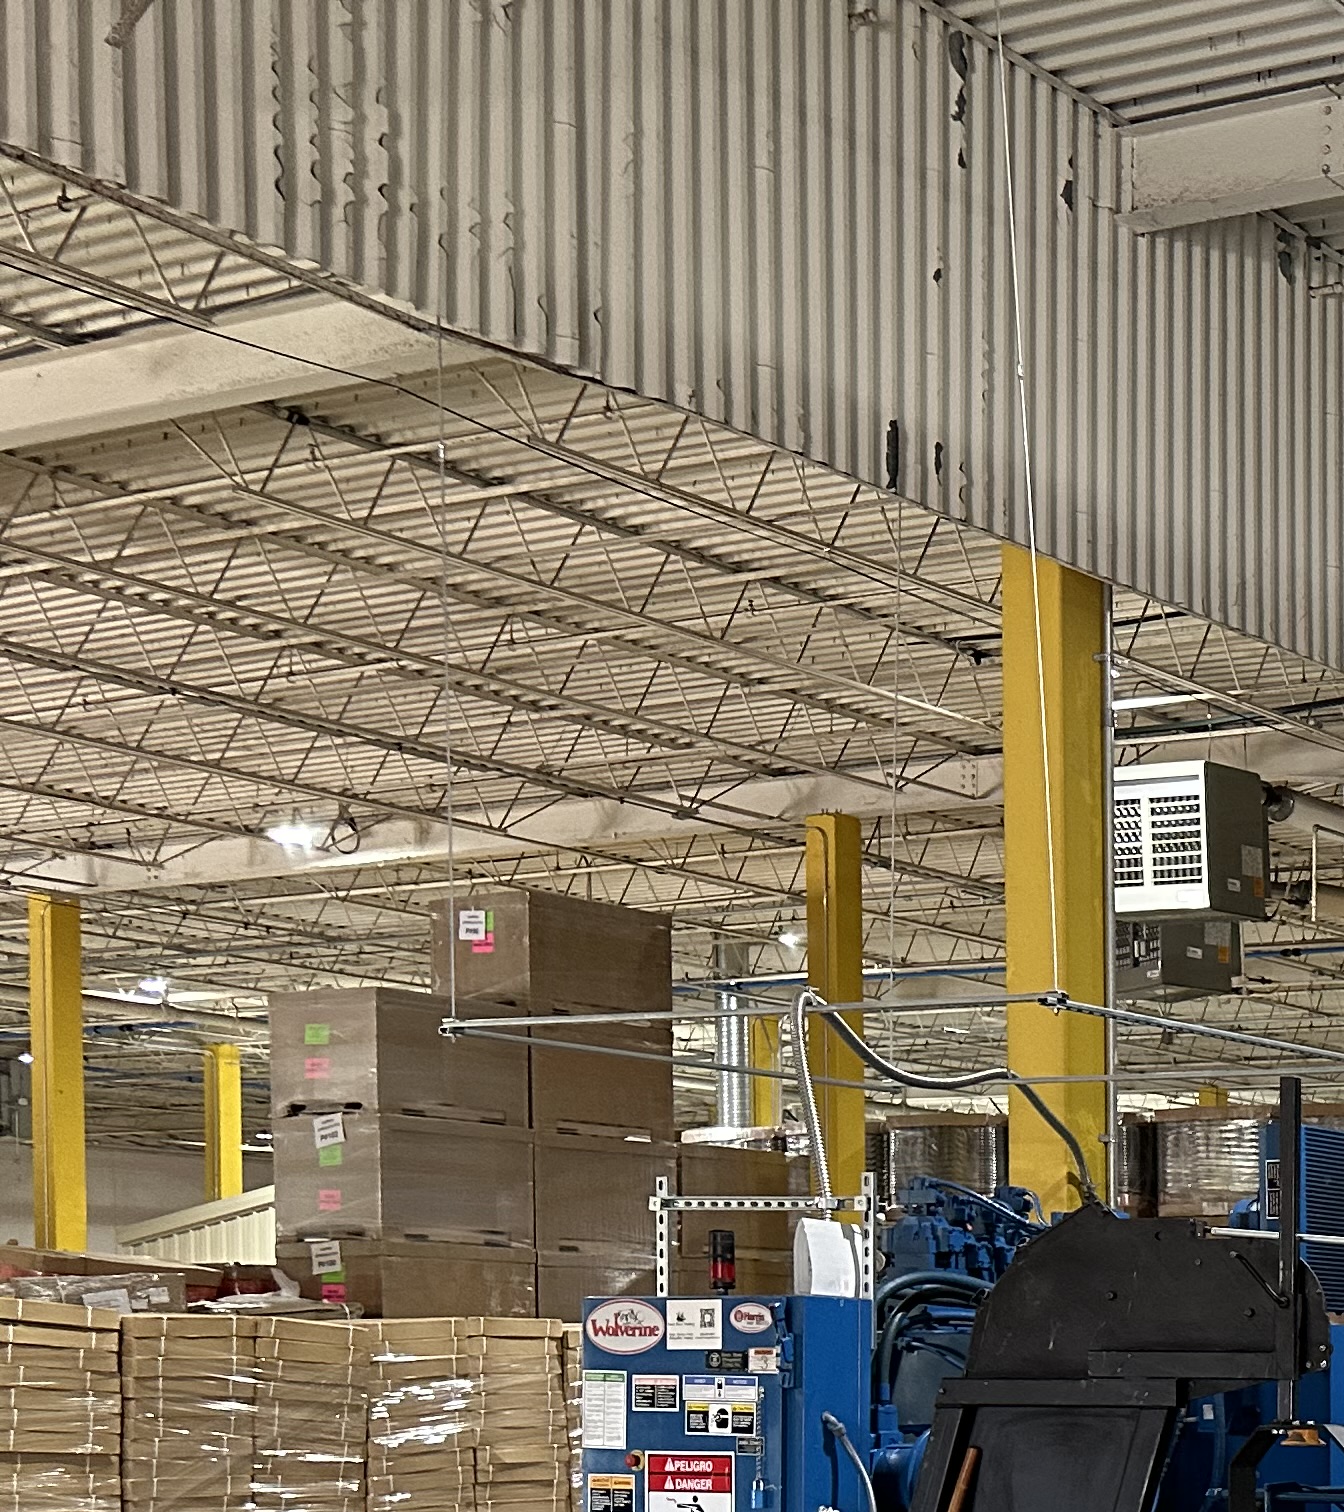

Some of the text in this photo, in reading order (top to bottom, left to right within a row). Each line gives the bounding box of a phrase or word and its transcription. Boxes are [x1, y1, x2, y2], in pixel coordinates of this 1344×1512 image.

[590, 1312, 660, 1337] Wolverine
[674, 1460, 713, 1472] PELIGRO
[675, 1478, 713, 1490] DANGER
